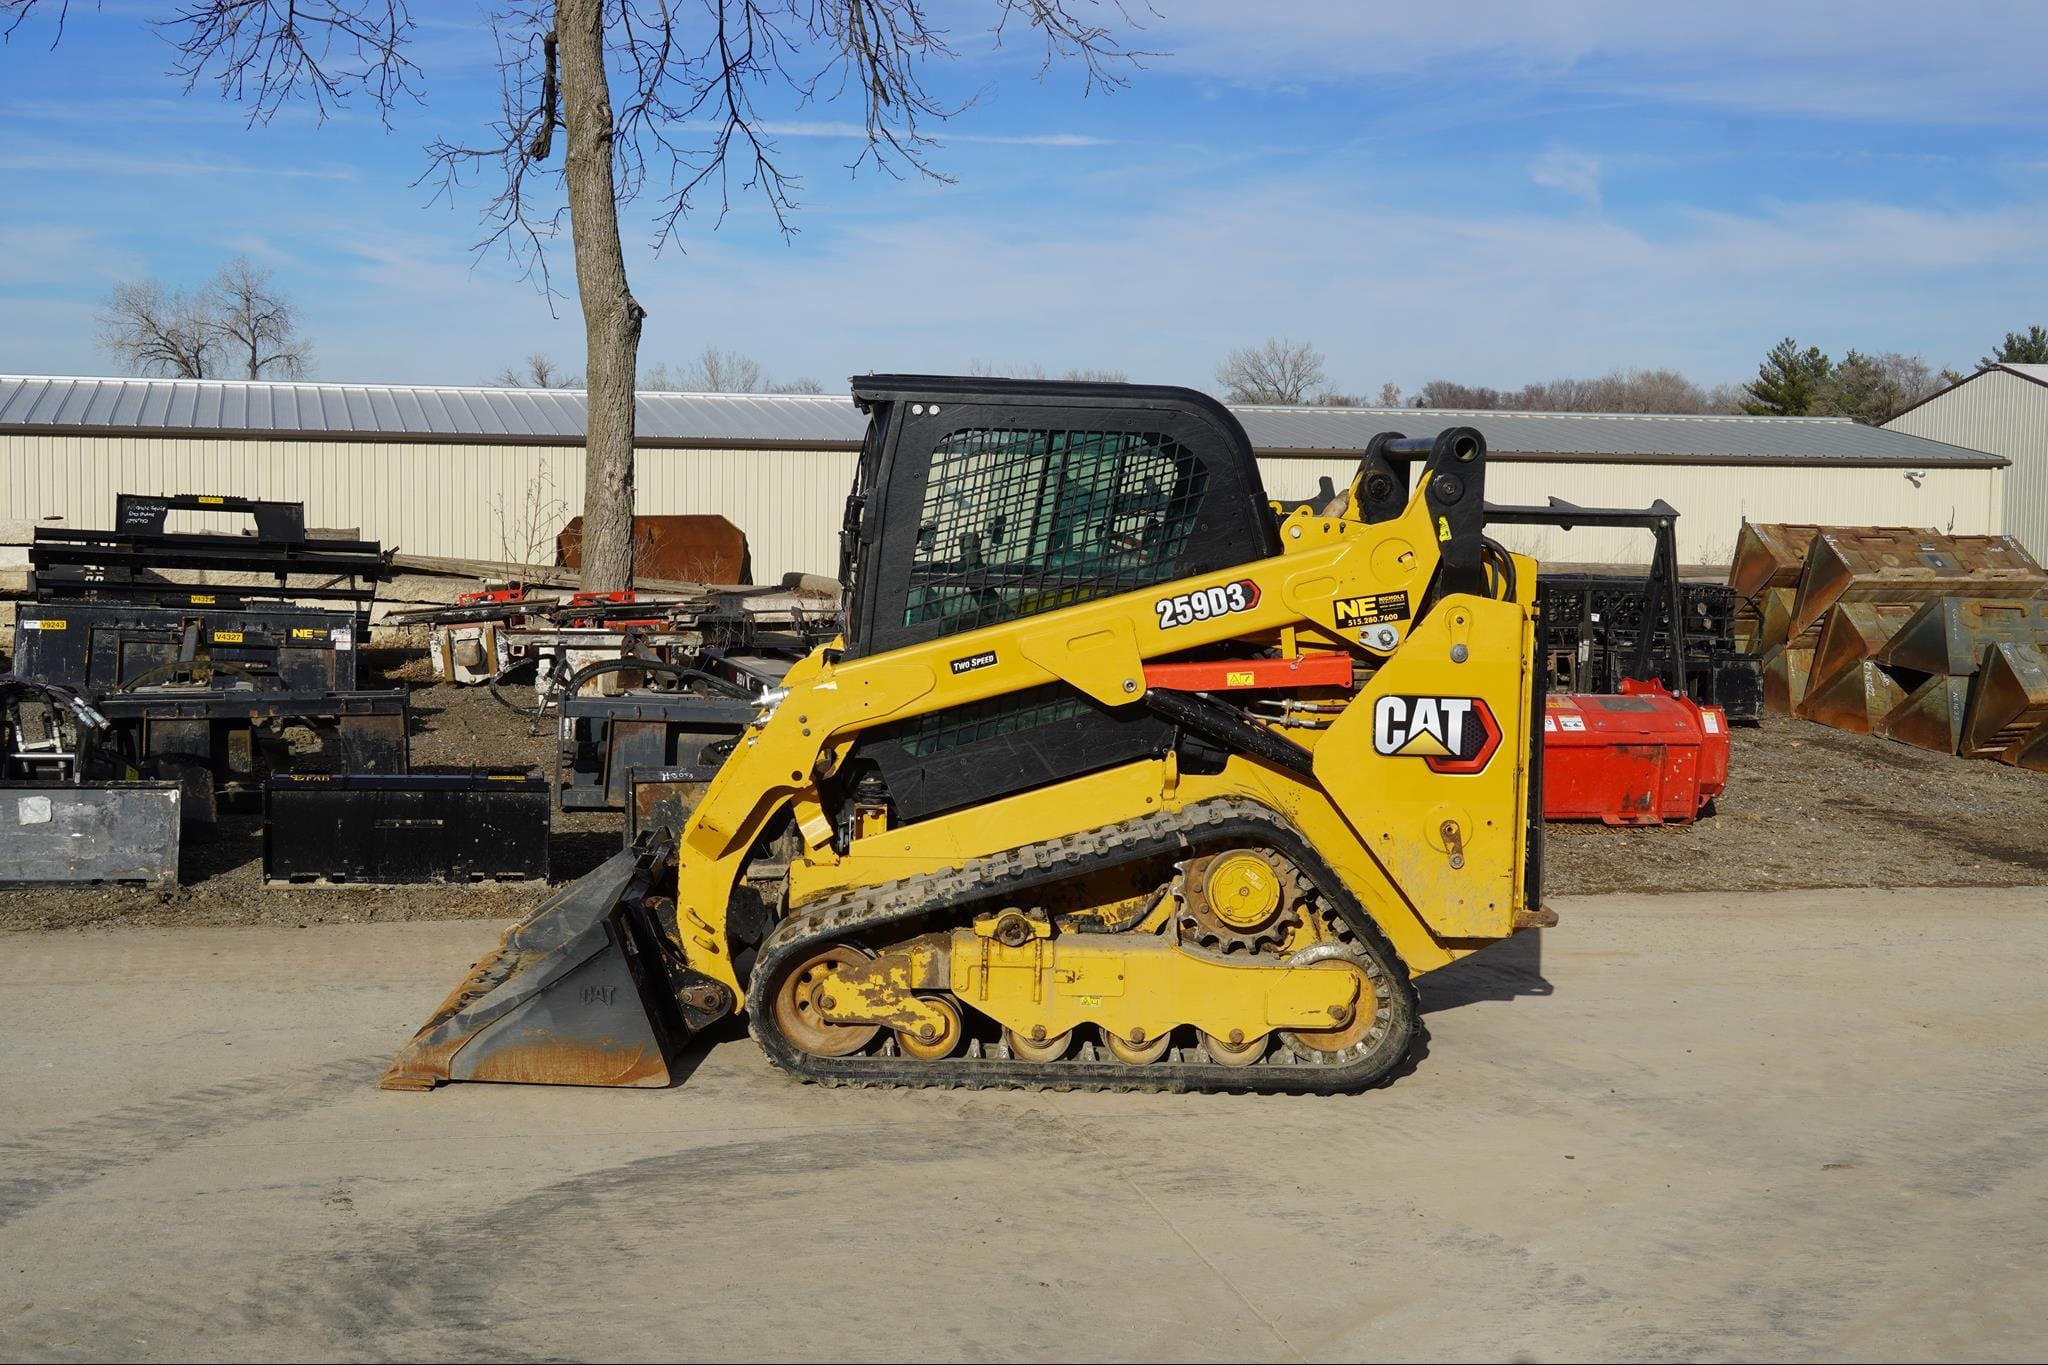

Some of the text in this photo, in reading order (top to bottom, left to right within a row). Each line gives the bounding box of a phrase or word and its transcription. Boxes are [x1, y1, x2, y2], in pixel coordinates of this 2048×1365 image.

[1157, 583, 1246, 629] 259D3
[1336, 597, 1378, 620] NE
[41, 620, 65, 628] V9243
[1348, 613, 1398, 627] 515.280.7600
[216, 633, 241, 641] V4327
[292, 628, 313, 638] NE
[1375, 696, 1471, 756] CAT
[580, 984, 617, 1008] CAT
